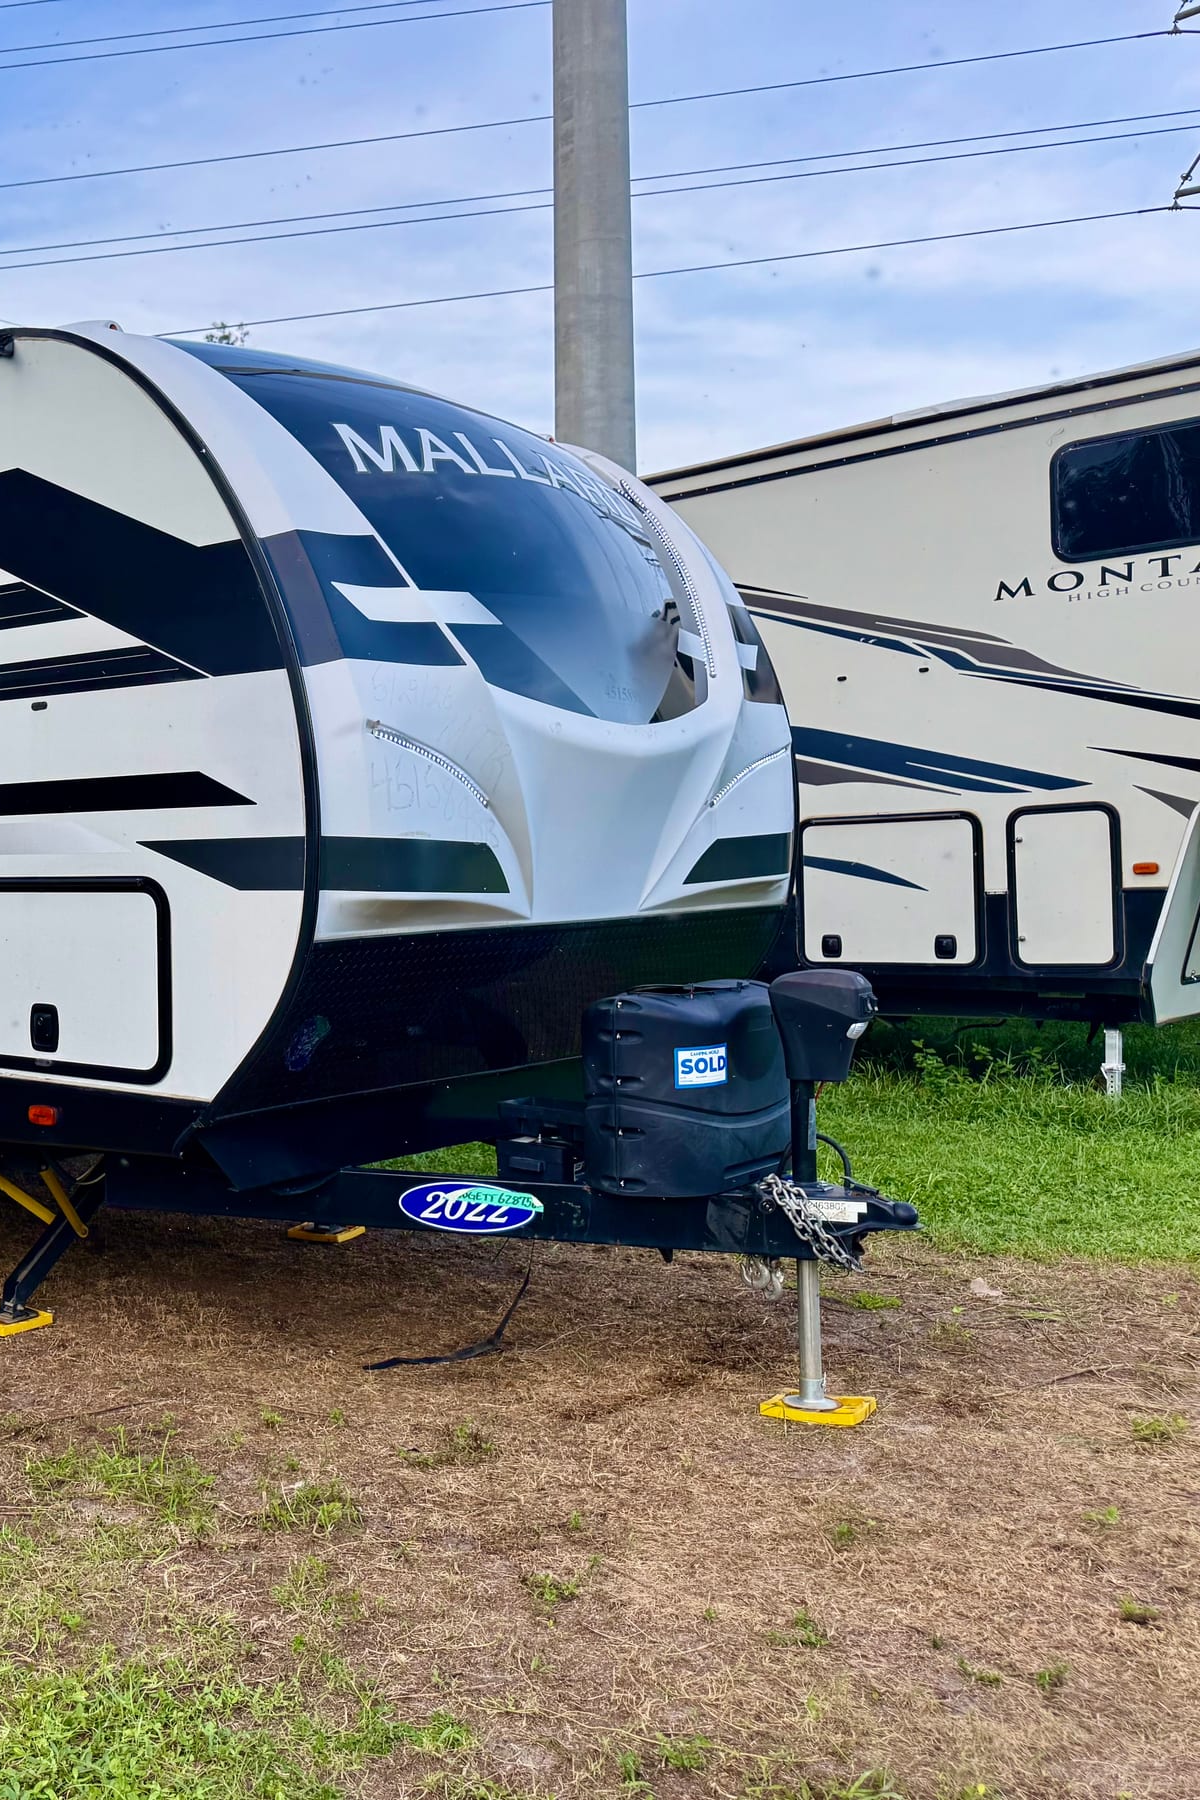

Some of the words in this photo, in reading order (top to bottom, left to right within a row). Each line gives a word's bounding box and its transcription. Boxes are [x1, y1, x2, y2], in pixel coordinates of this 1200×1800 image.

[330, 422, 646, 531] MALLARD
[1068, 585, 1130, 602] HIGH
[680, 1055, 727, 1075] SOLD
[419, 1190, 510, 1223] 2022
